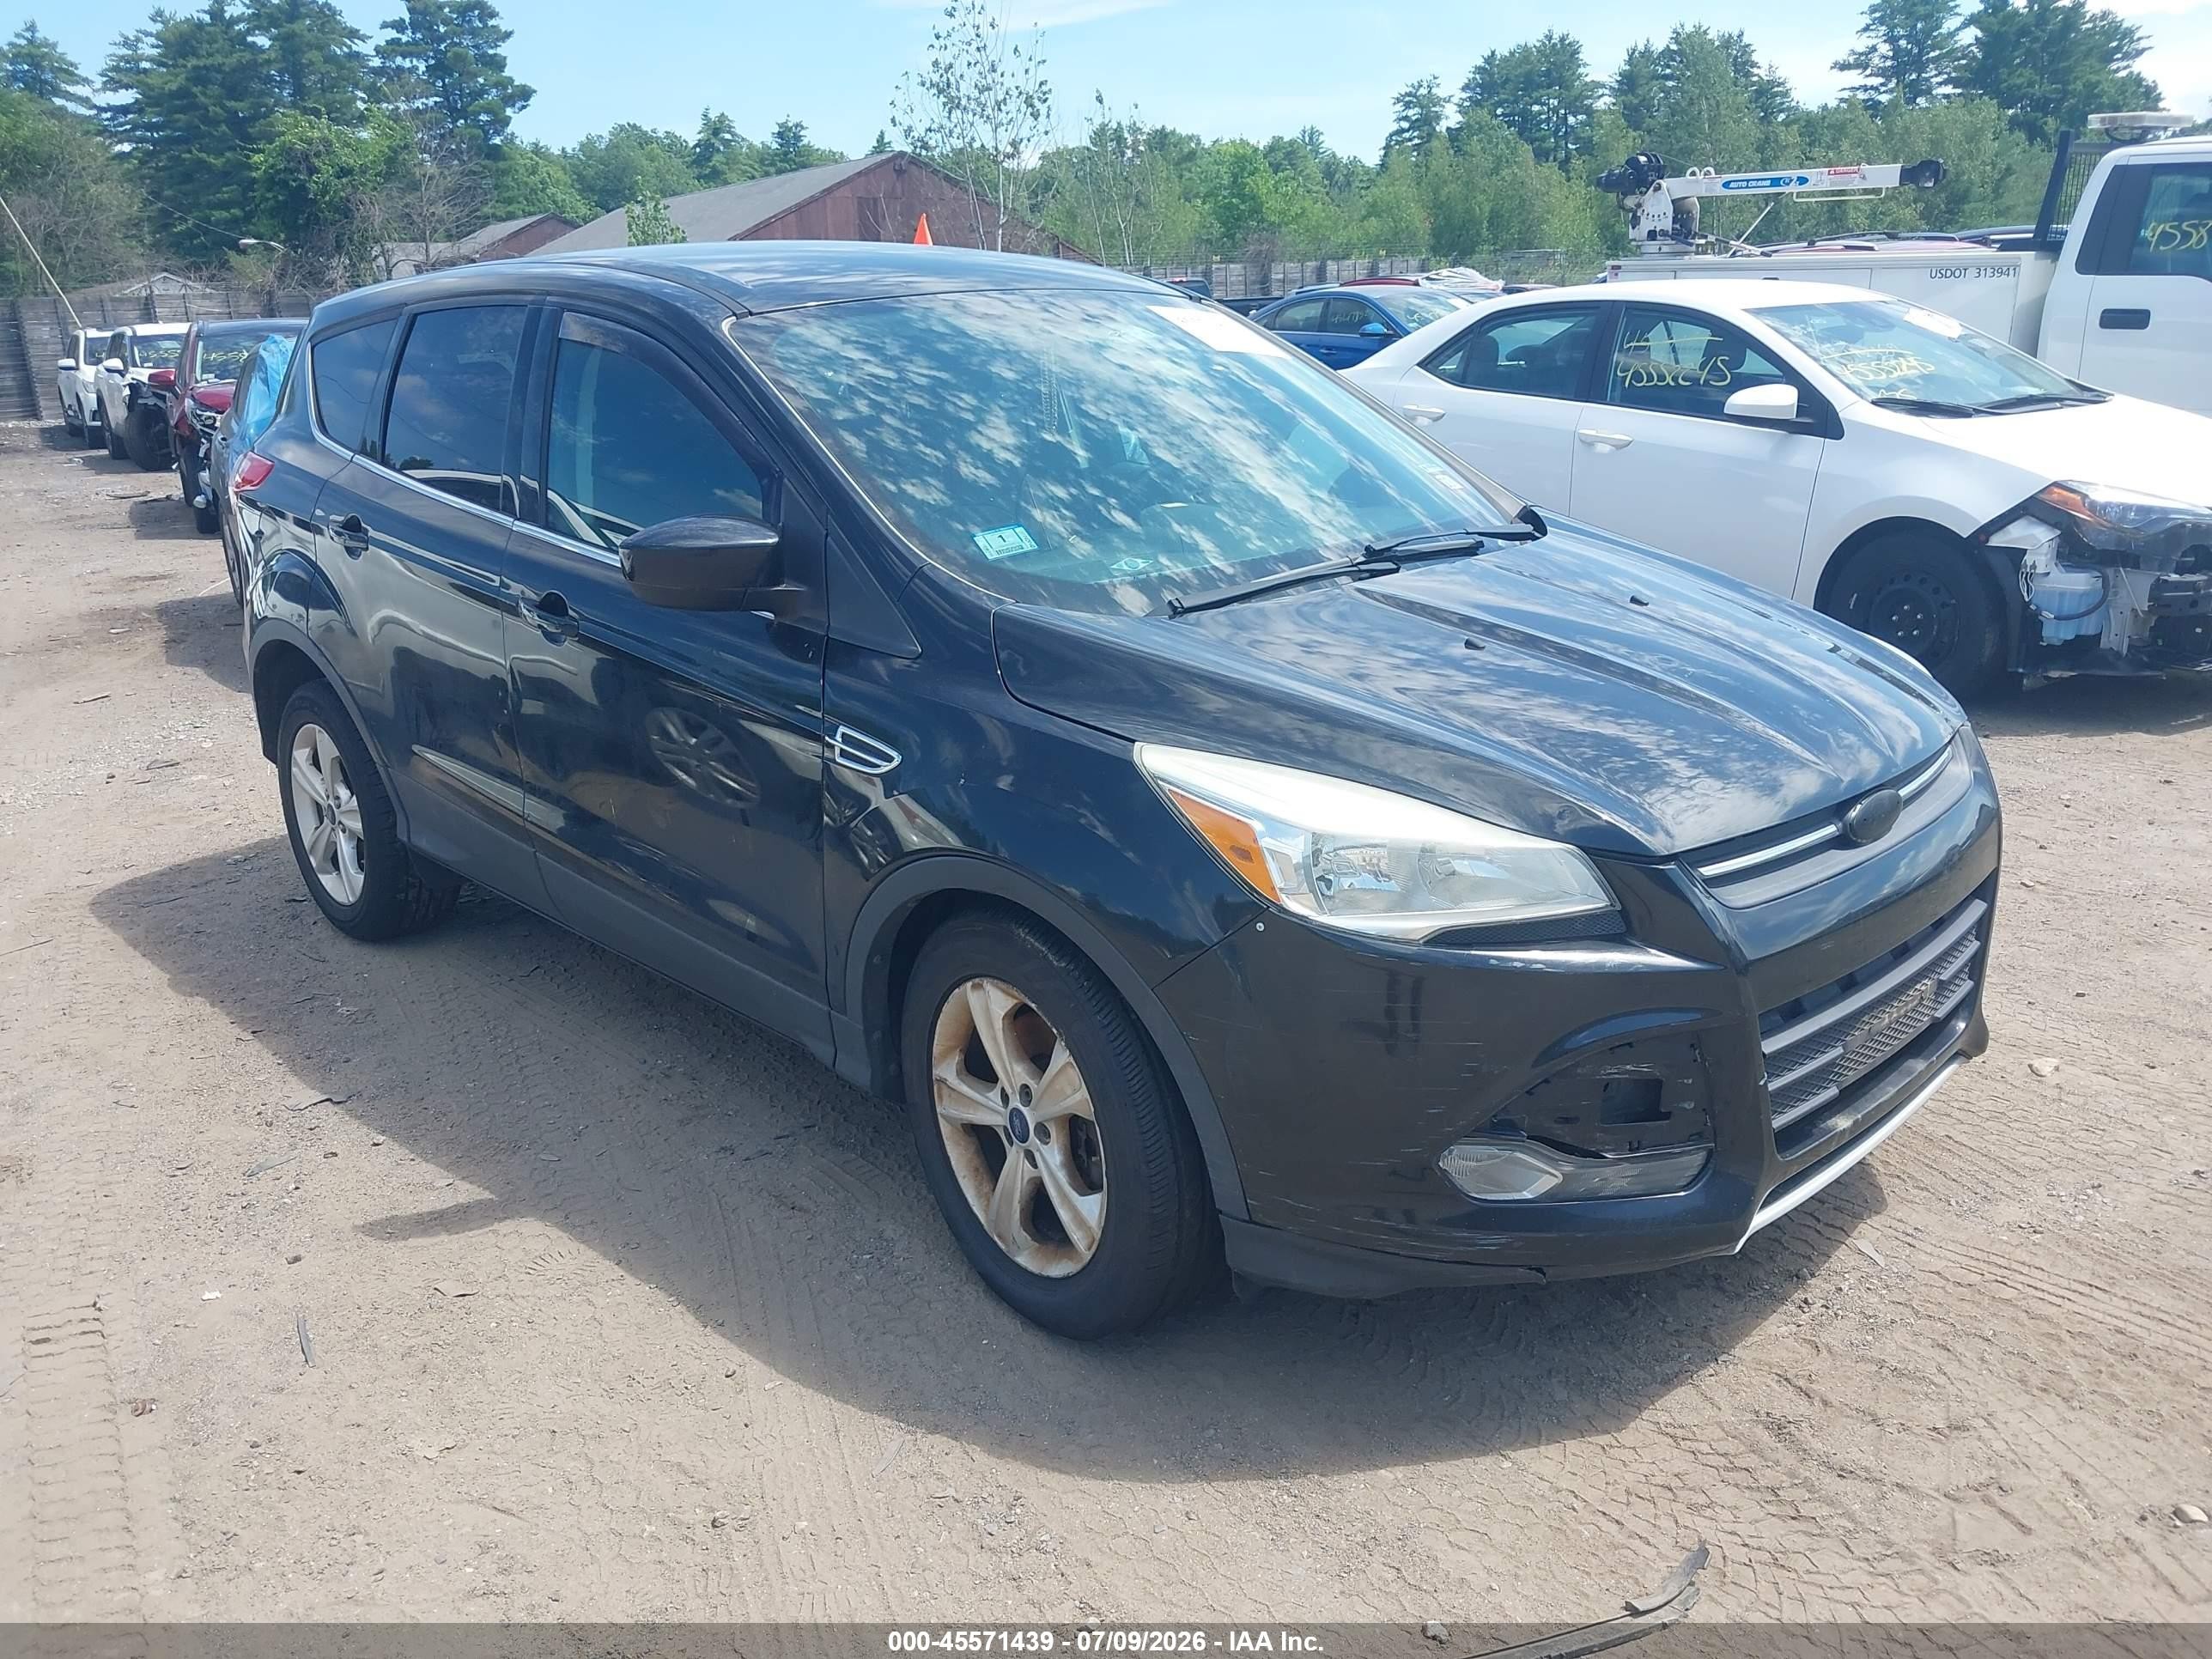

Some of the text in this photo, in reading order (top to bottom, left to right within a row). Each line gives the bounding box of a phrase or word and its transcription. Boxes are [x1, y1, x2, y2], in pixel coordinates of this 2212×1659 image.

[1929, 267, 2017, 279] USDOT 313941
[997, 534, 1007, 544] 1
